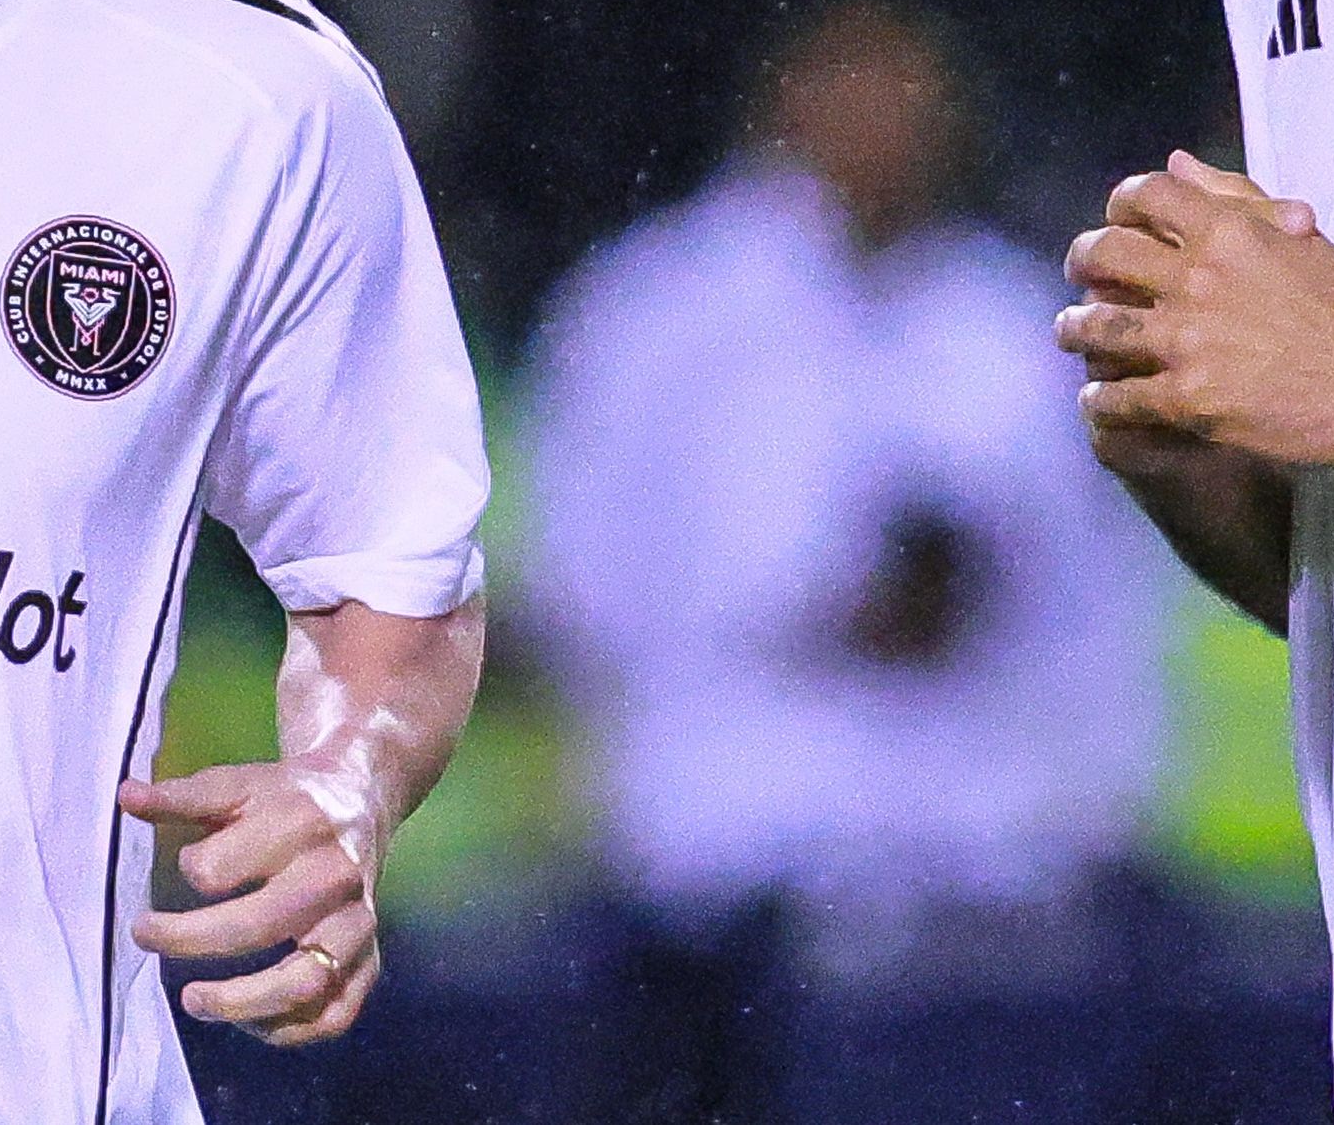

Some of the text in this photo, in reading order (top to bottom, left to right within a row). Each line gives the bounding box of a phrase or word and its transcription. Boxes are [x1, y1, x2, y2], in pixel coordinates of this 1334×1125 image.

[11, 226, 148, 287] INTERNACIONAL
[59, 261, 125, 286] MIAMI
[146, 266, 165, 291] DE
[8, 295, 30, 344] CLUB
[55, 369, 107, 391] MMXX
